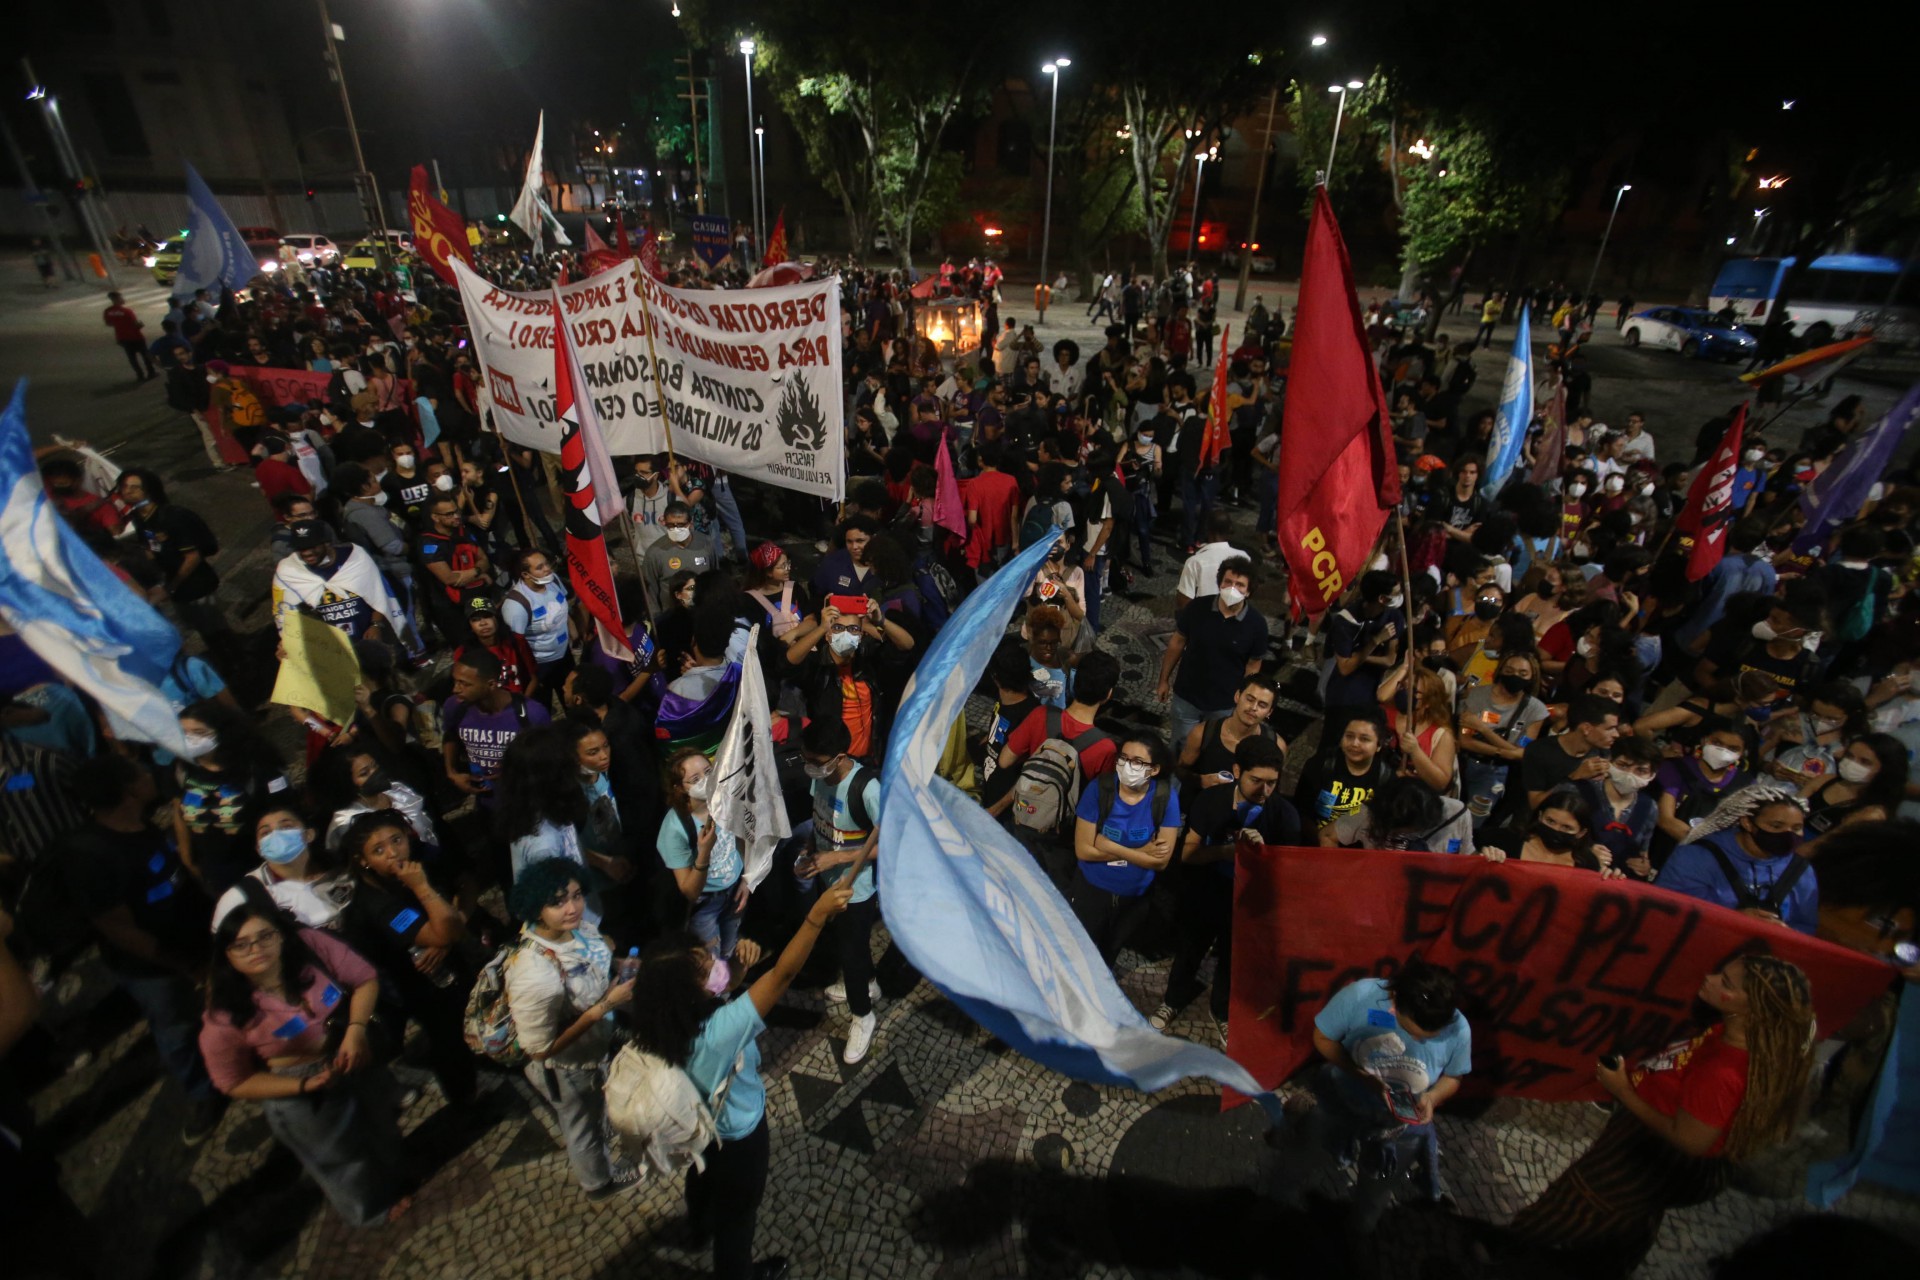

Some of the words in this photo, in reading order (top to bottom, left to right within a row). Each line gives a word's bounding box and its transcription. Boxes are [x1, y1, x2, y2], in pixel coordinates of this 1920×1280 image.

[693, 221, 727, 234] CASUAL
[567, 549, 590, 581] TUDE
[1301, 526, 1343, 603] PCR
[322, 608, 360, 622] RASIL
[459, 727, 493, 744] LETRAS
[1405, 866, 1559, 963] ECO
